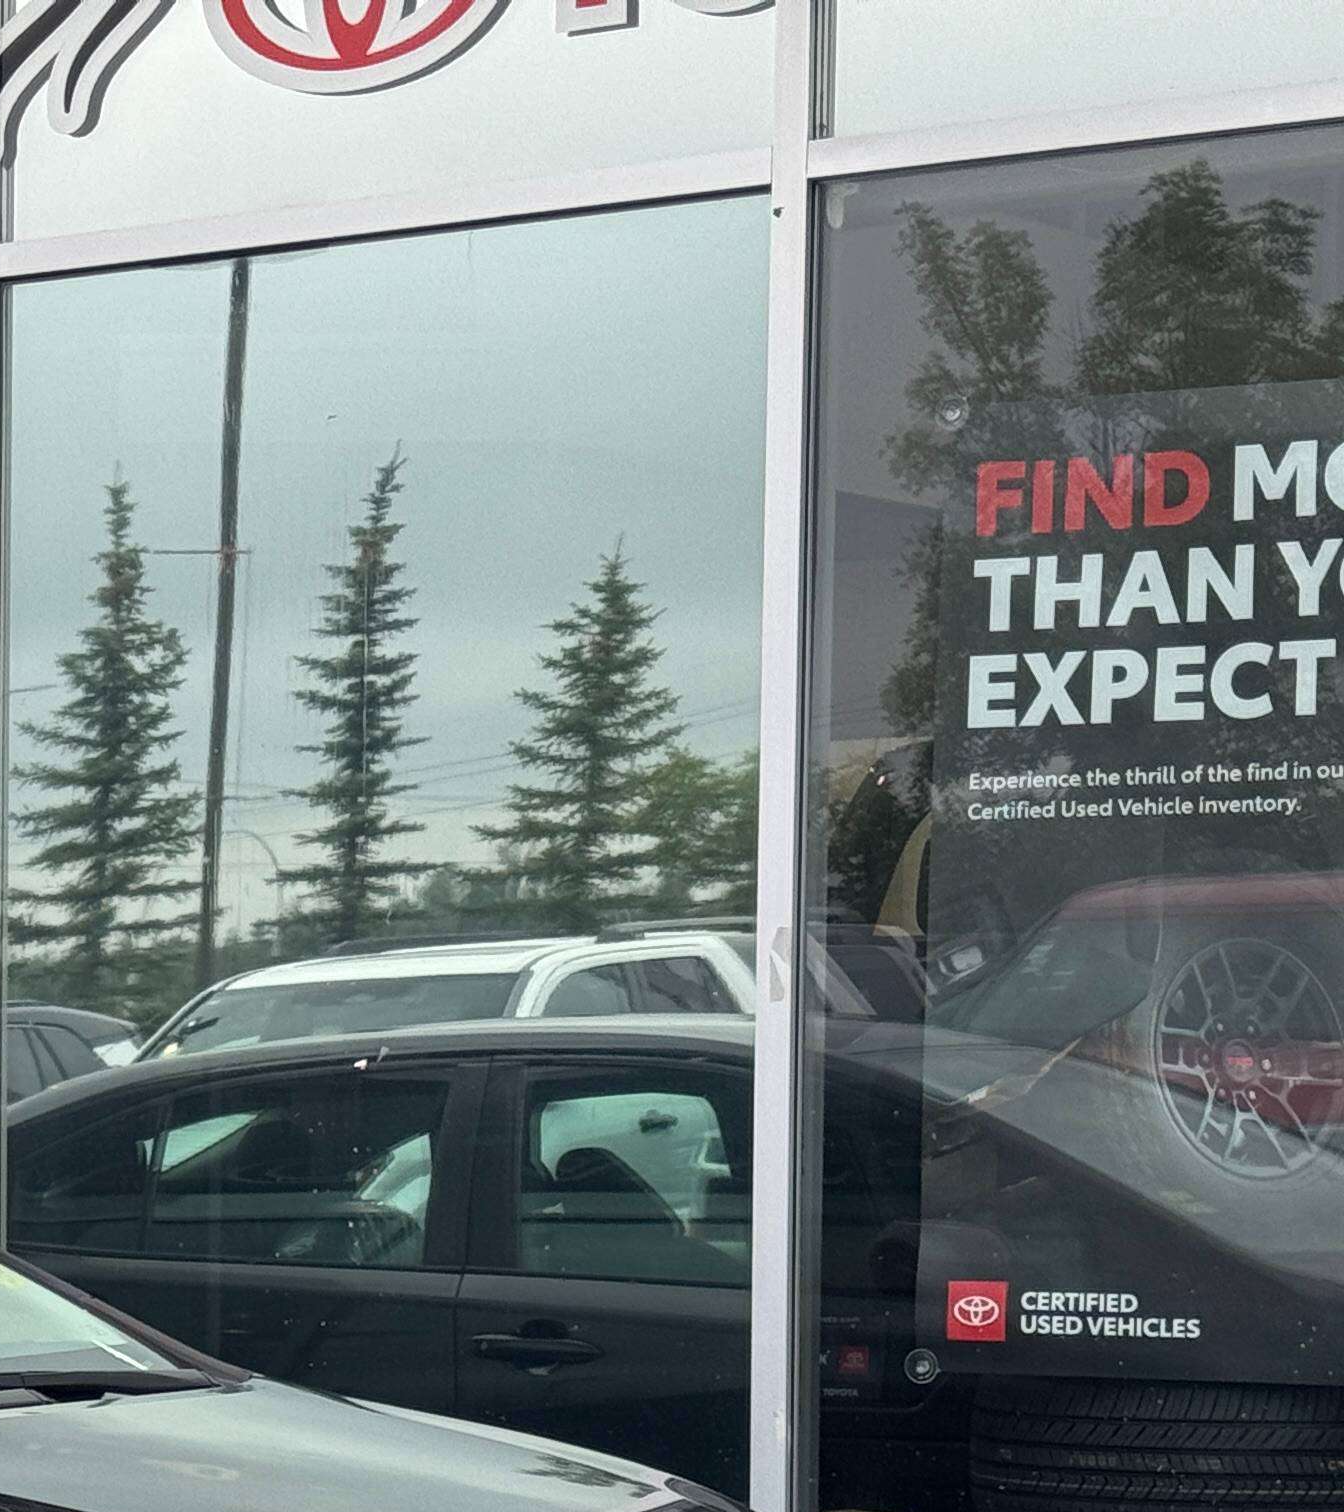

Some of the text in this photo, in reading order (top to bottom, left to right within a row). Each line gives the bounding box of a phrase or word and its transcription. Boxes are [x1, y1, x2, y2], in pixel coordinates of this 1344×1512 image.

[976, 439, 1344, 537] FIND M
[973, 538, 1344, 633] THAN Y
[967, 638, 1337, 729] EXPECT
[968, 770, 1082, 793] Experience
[1086, 768, 1121, 787] the
[1125, 766, 1177, 785] thrill
[1181, 764, 1204, 784] of
[1208, 764, 1243, 783] the
[1247, 761, 1288, 782] find
[1292, 761, 1312, 780] in
[967, 800, 1056, 821] Certified
[1062, 799, 1113, 818] Used
[1117, 796, 1194, 816] Vehicle
[1020, 1291, 1139, 1313] CERTIFIED
[1020, 1314, 1202, 1339] USED VEHICLES
